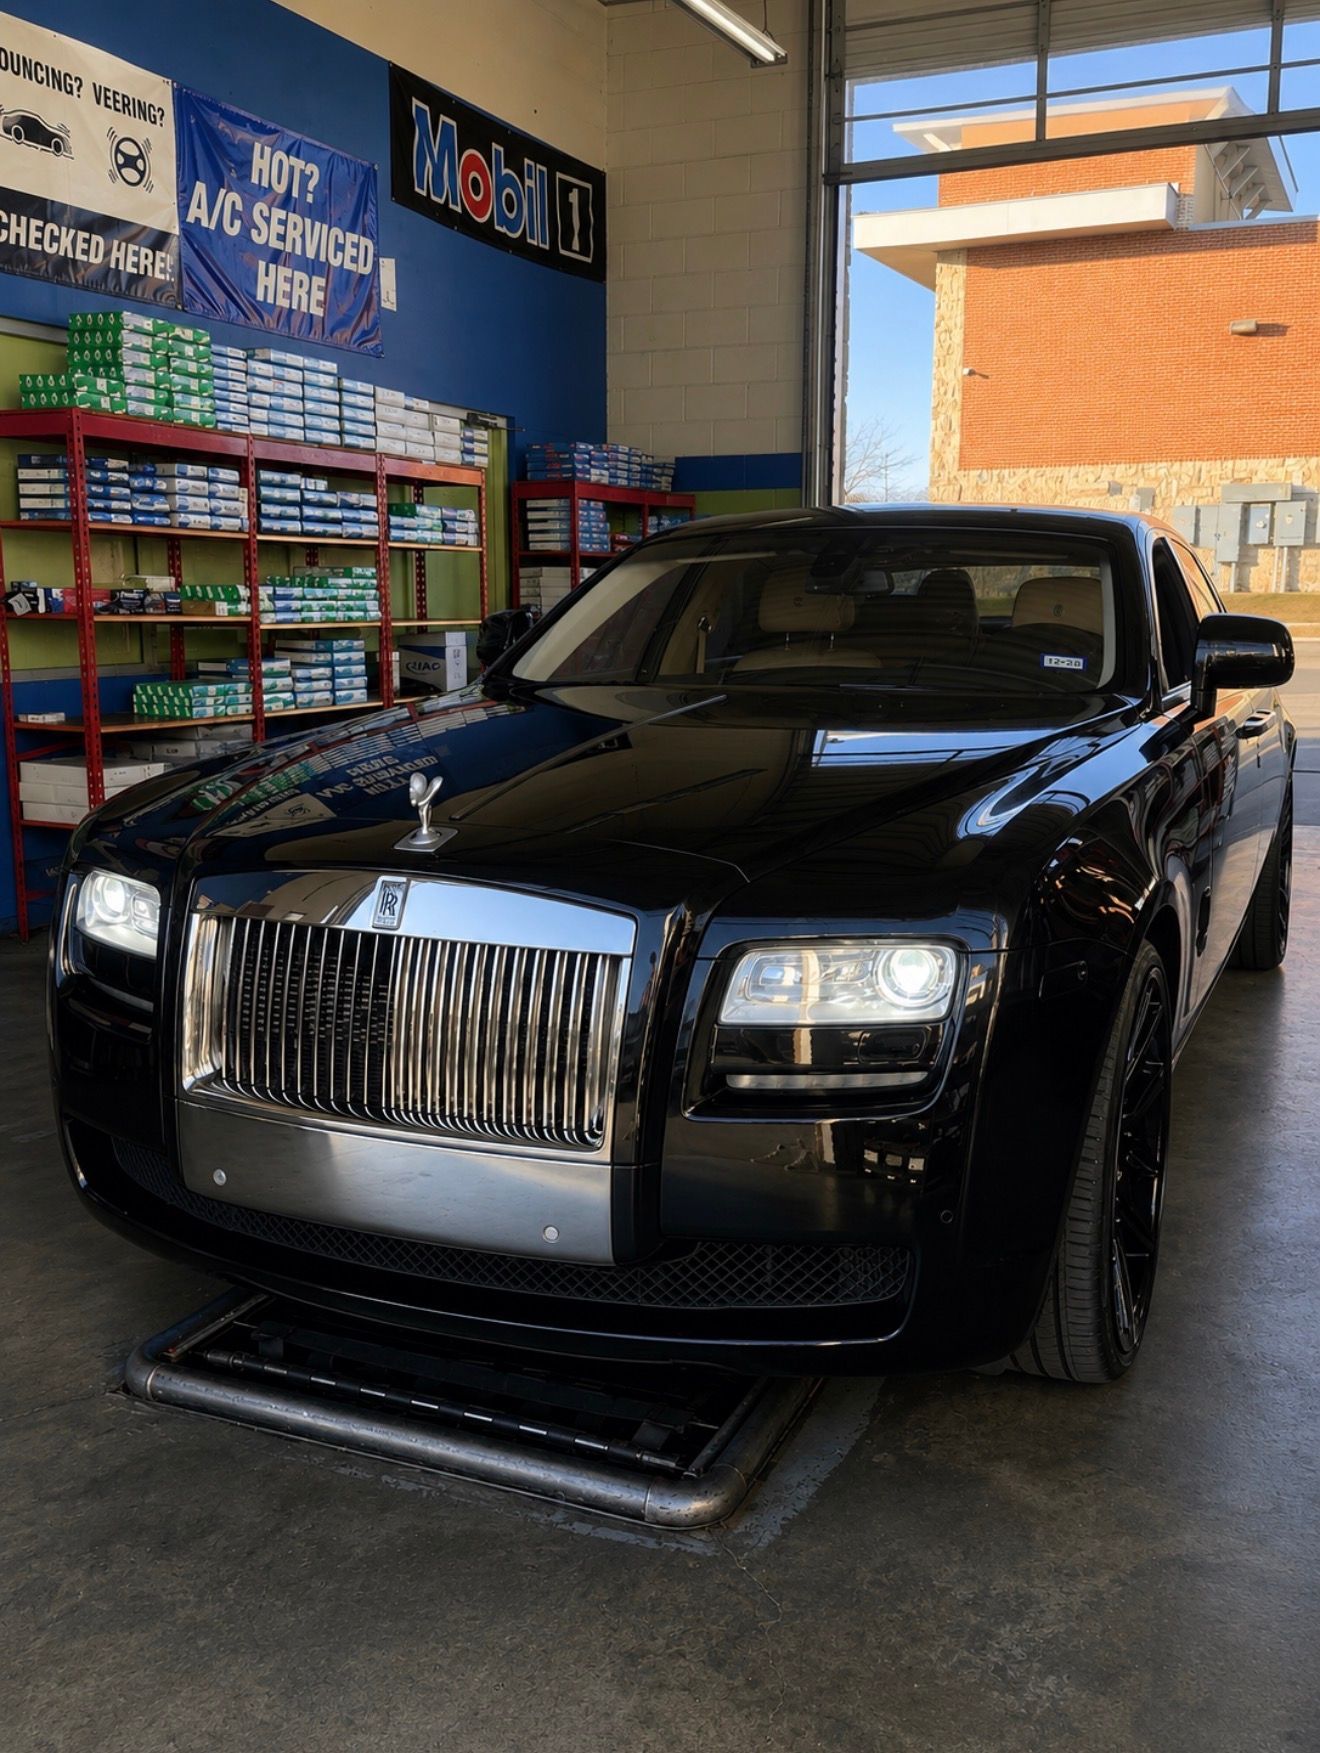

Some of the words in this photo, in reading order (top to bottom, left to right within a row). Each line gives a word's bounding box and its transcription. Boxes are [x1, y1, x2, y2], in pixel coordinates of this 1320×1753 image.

[92, 82, 165, 127] VEERING?
[251, 141, 320, 204] HOT?
[412, 96, 549, 250] Mobil
[568, 188, 581, 252] 1
[185, 180, 243, 237] A/C
[250, 201, 374, 275] SERVICED
[256, 260, 327, 317] HERE
